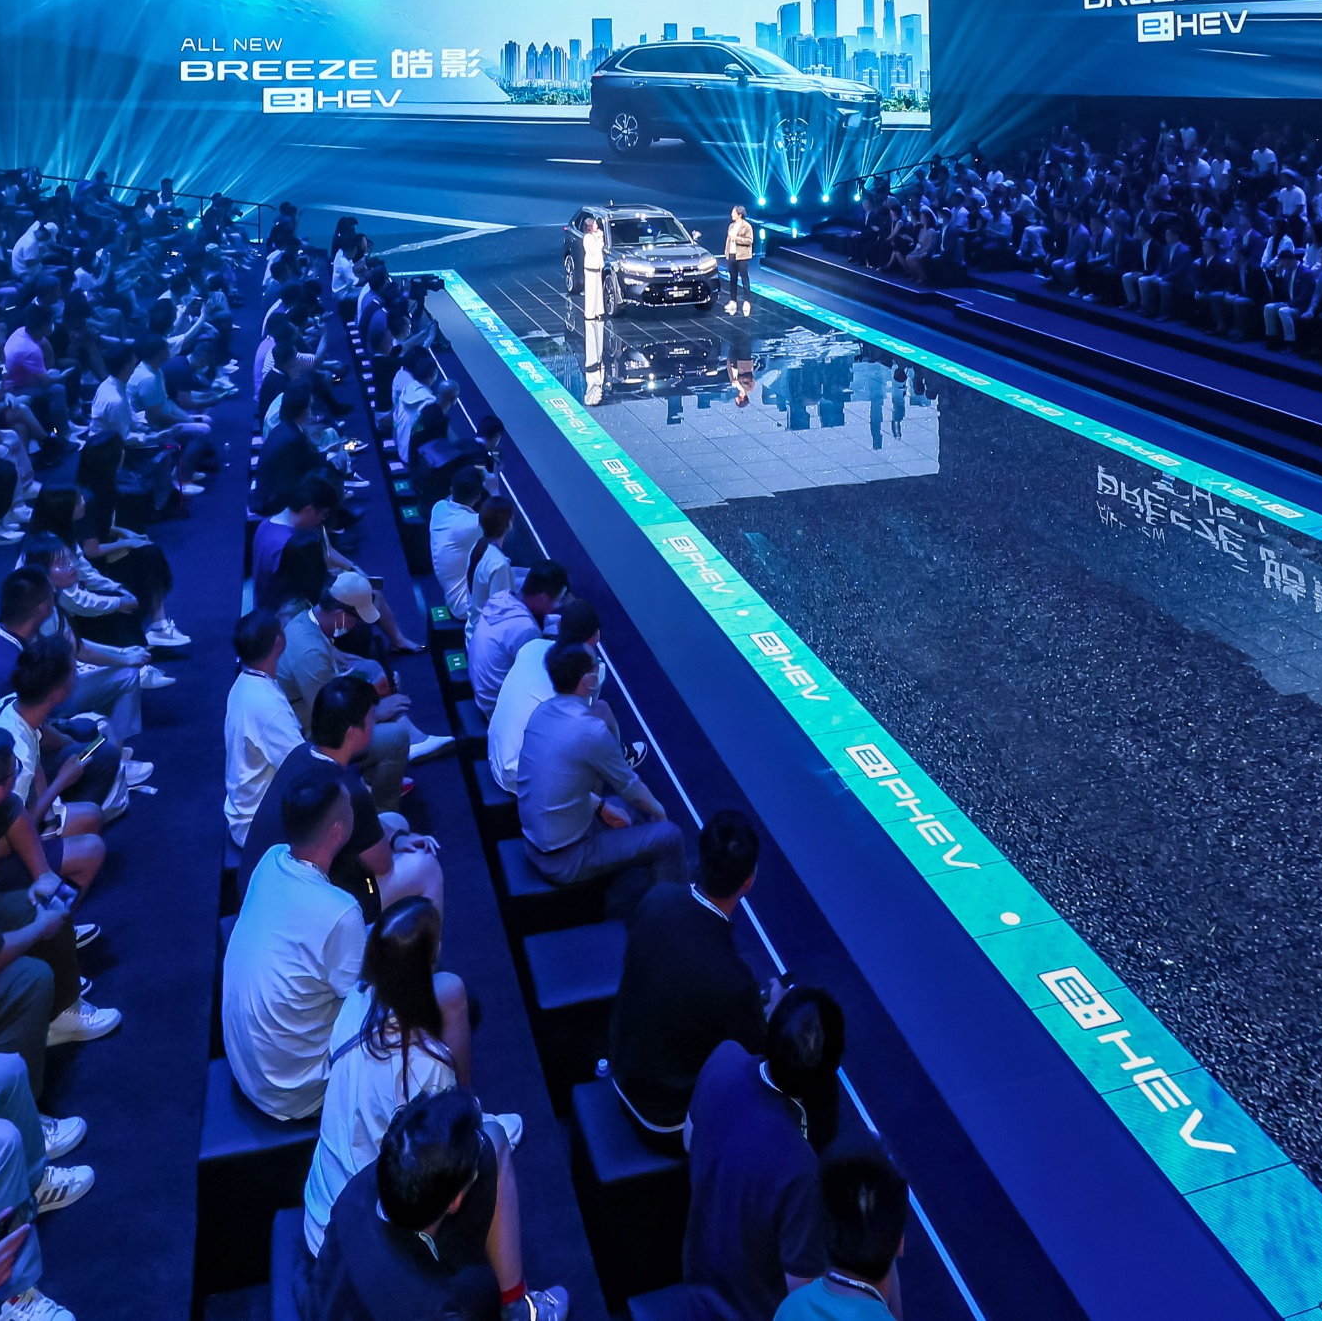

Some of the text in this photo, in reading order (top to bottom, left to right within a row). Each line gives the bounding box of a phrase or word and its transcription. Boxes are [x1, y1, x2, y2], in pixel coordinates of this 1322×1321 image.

[180, 37, 283, 52] ALL NEW
[180, 48, 481, 81] BREEZE 皓影
